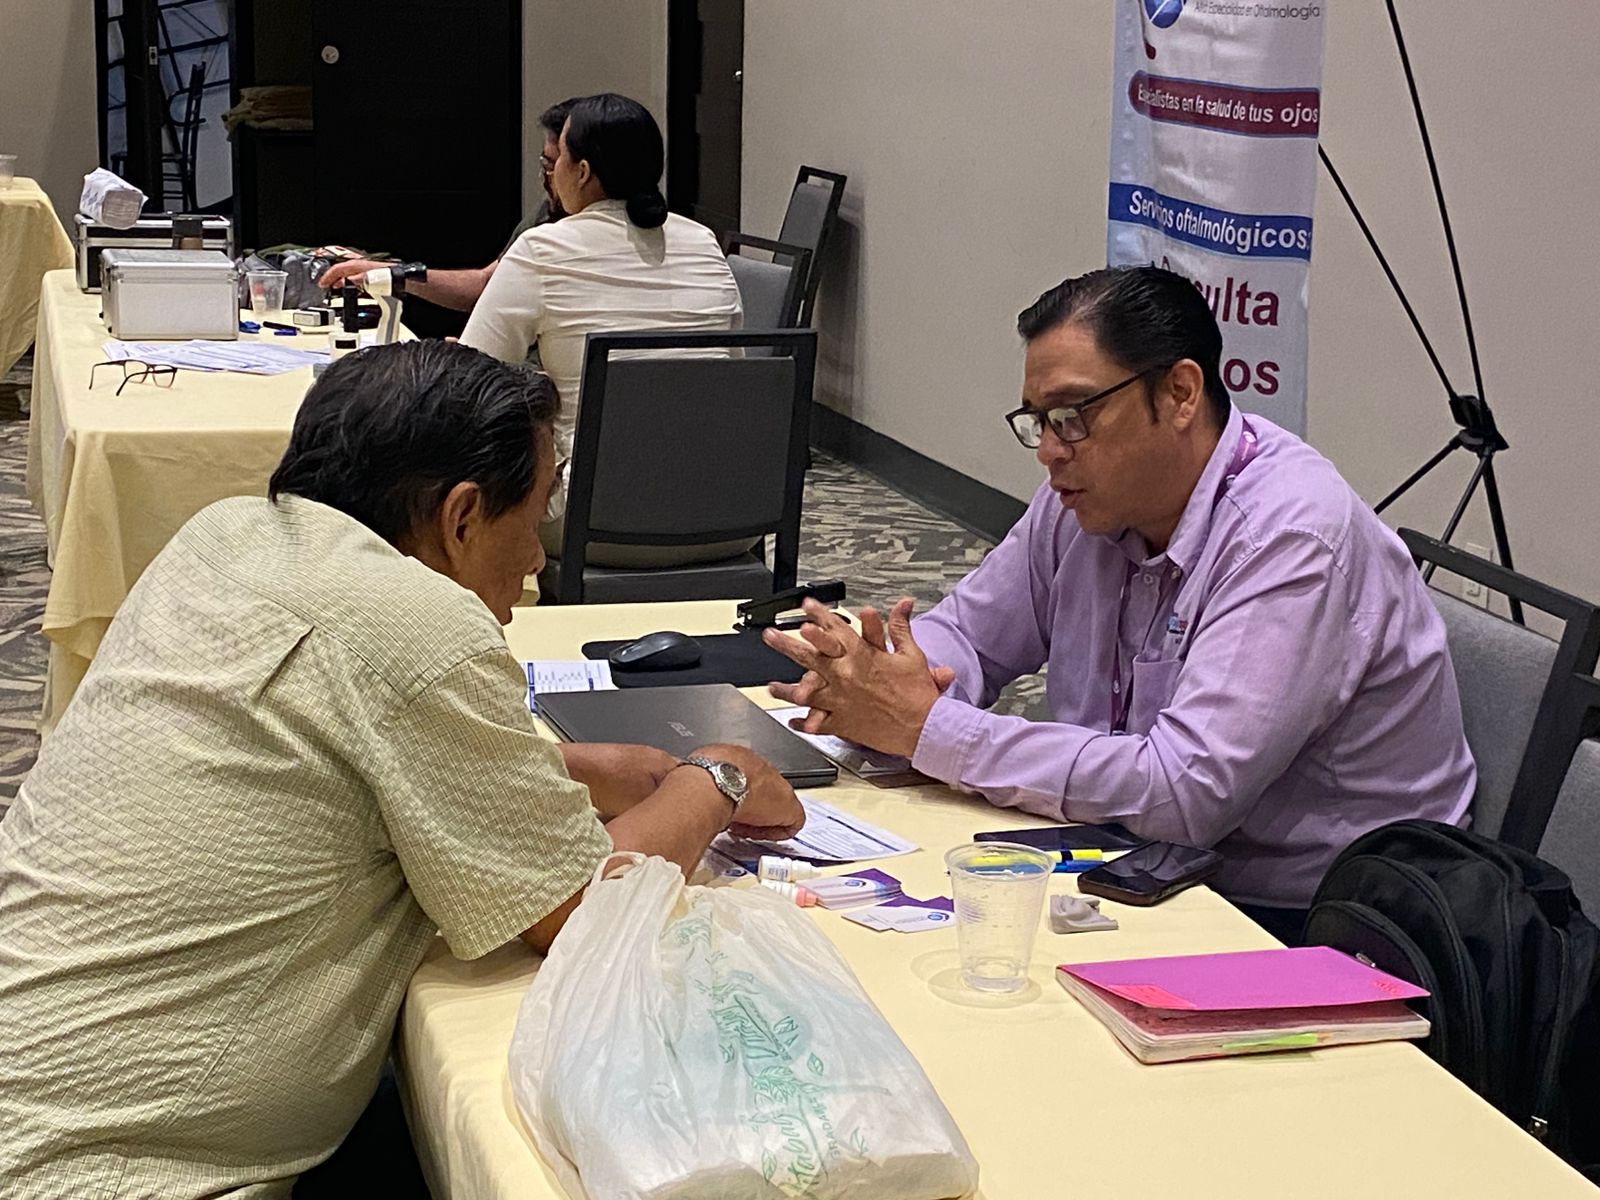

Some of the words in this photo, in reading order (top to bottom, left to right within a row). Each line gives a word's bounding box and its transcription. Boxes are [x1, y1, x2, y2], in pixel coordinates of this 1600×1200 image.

[1181, 97, 1194, 113] en
[1195, 94, 1204, 114] la
[1205, 97, 1233, 118] salud
[1232, 100, 1246, 121] de
[1249, 103, 1274, 123] tus
[1280, 102, 1319, 128] ojos
